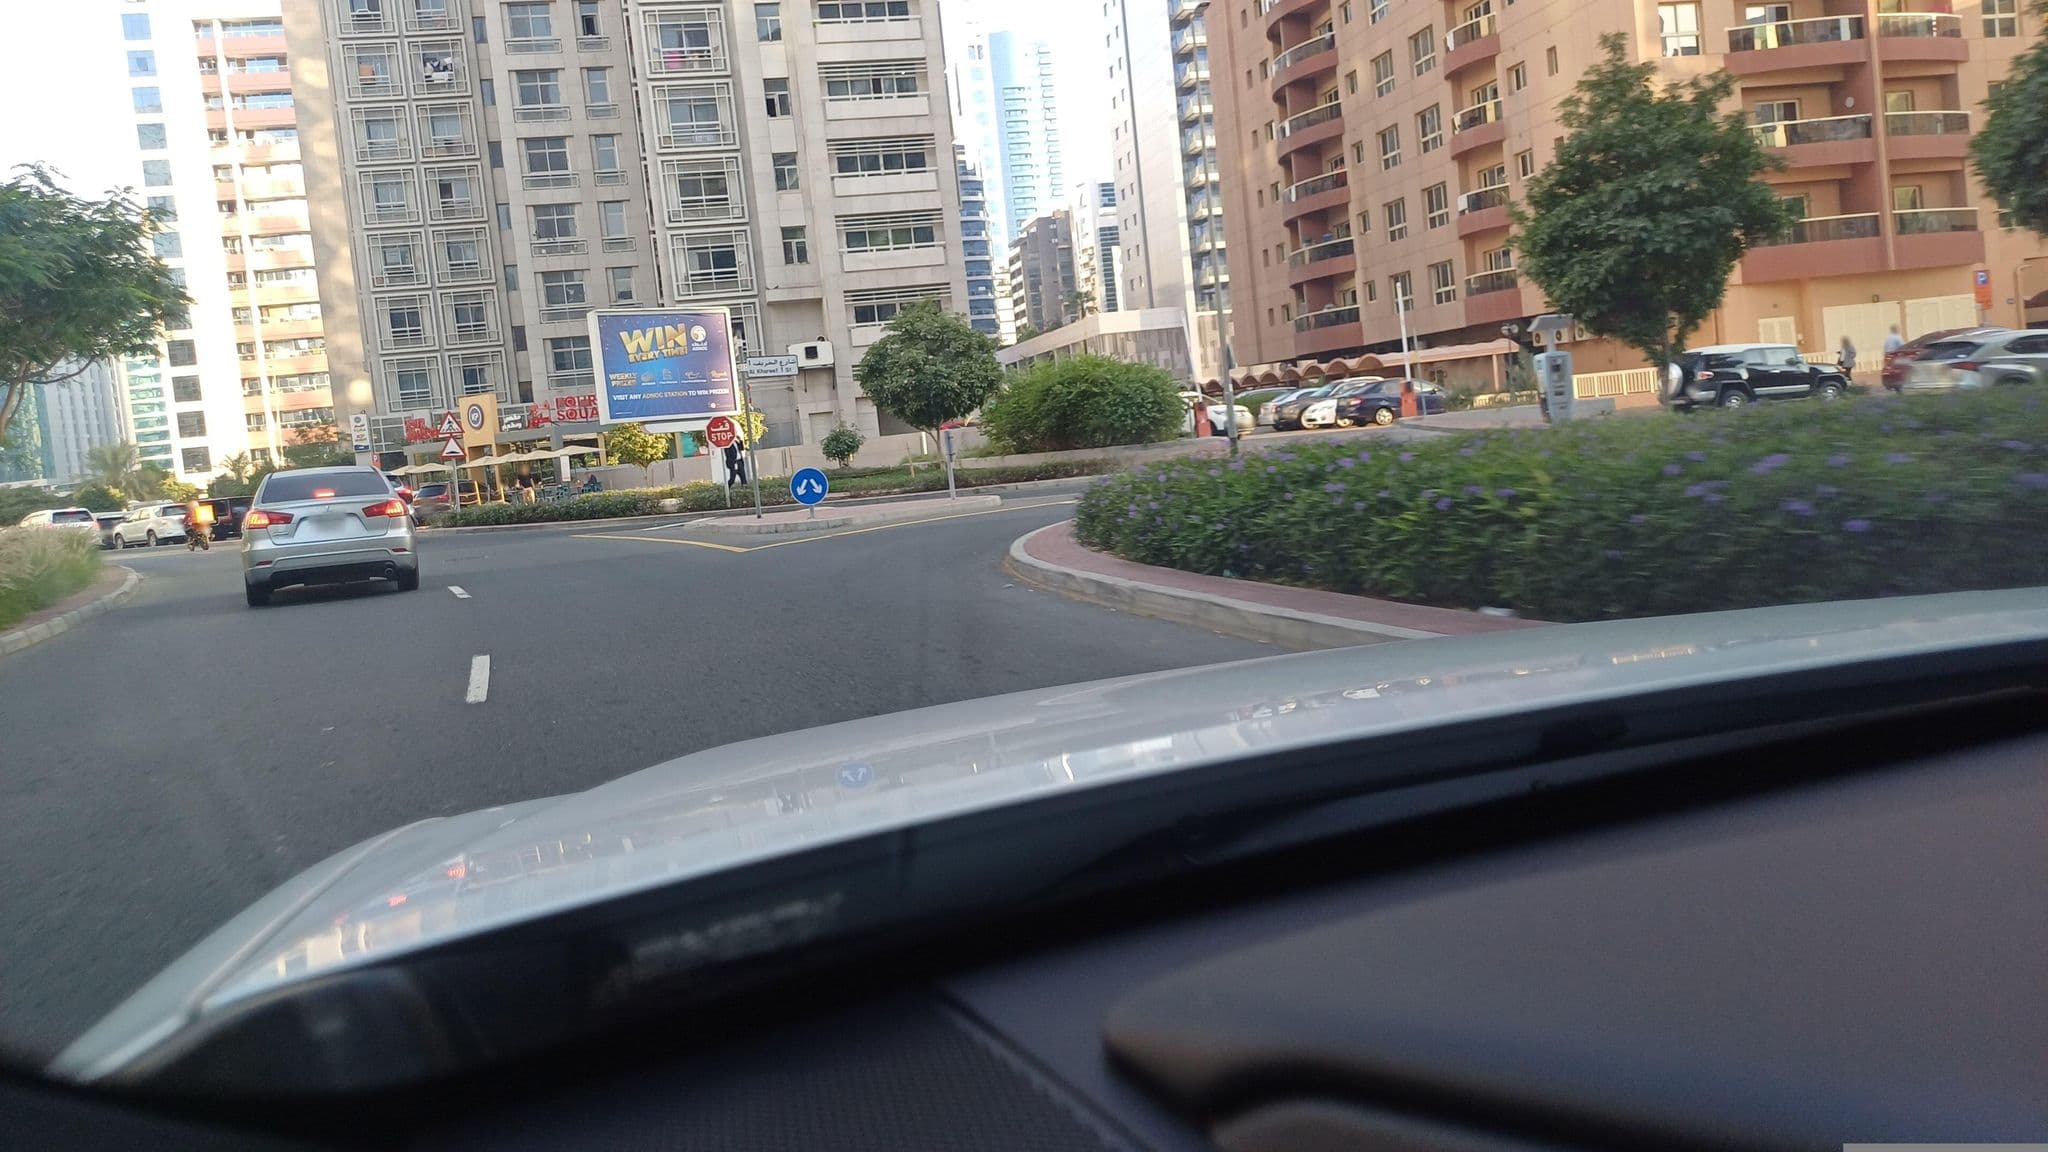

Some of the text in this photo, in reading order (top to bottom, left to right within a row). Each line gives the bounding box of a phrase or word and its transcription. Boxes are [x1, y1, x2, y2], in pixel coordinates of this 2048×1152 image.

[619, 323, 687, 355] WIN
[628, 350, 660, 364] EVERY
[629, 393, 642, 401] ANY
[642, 391, 664, 400] ADNOC
[663, 390, 689, 398] STATION
[688, 389, 697, 397] TO
[557, 407, 599, 421] SQUA
[711, 432, 734, 442] STOP
